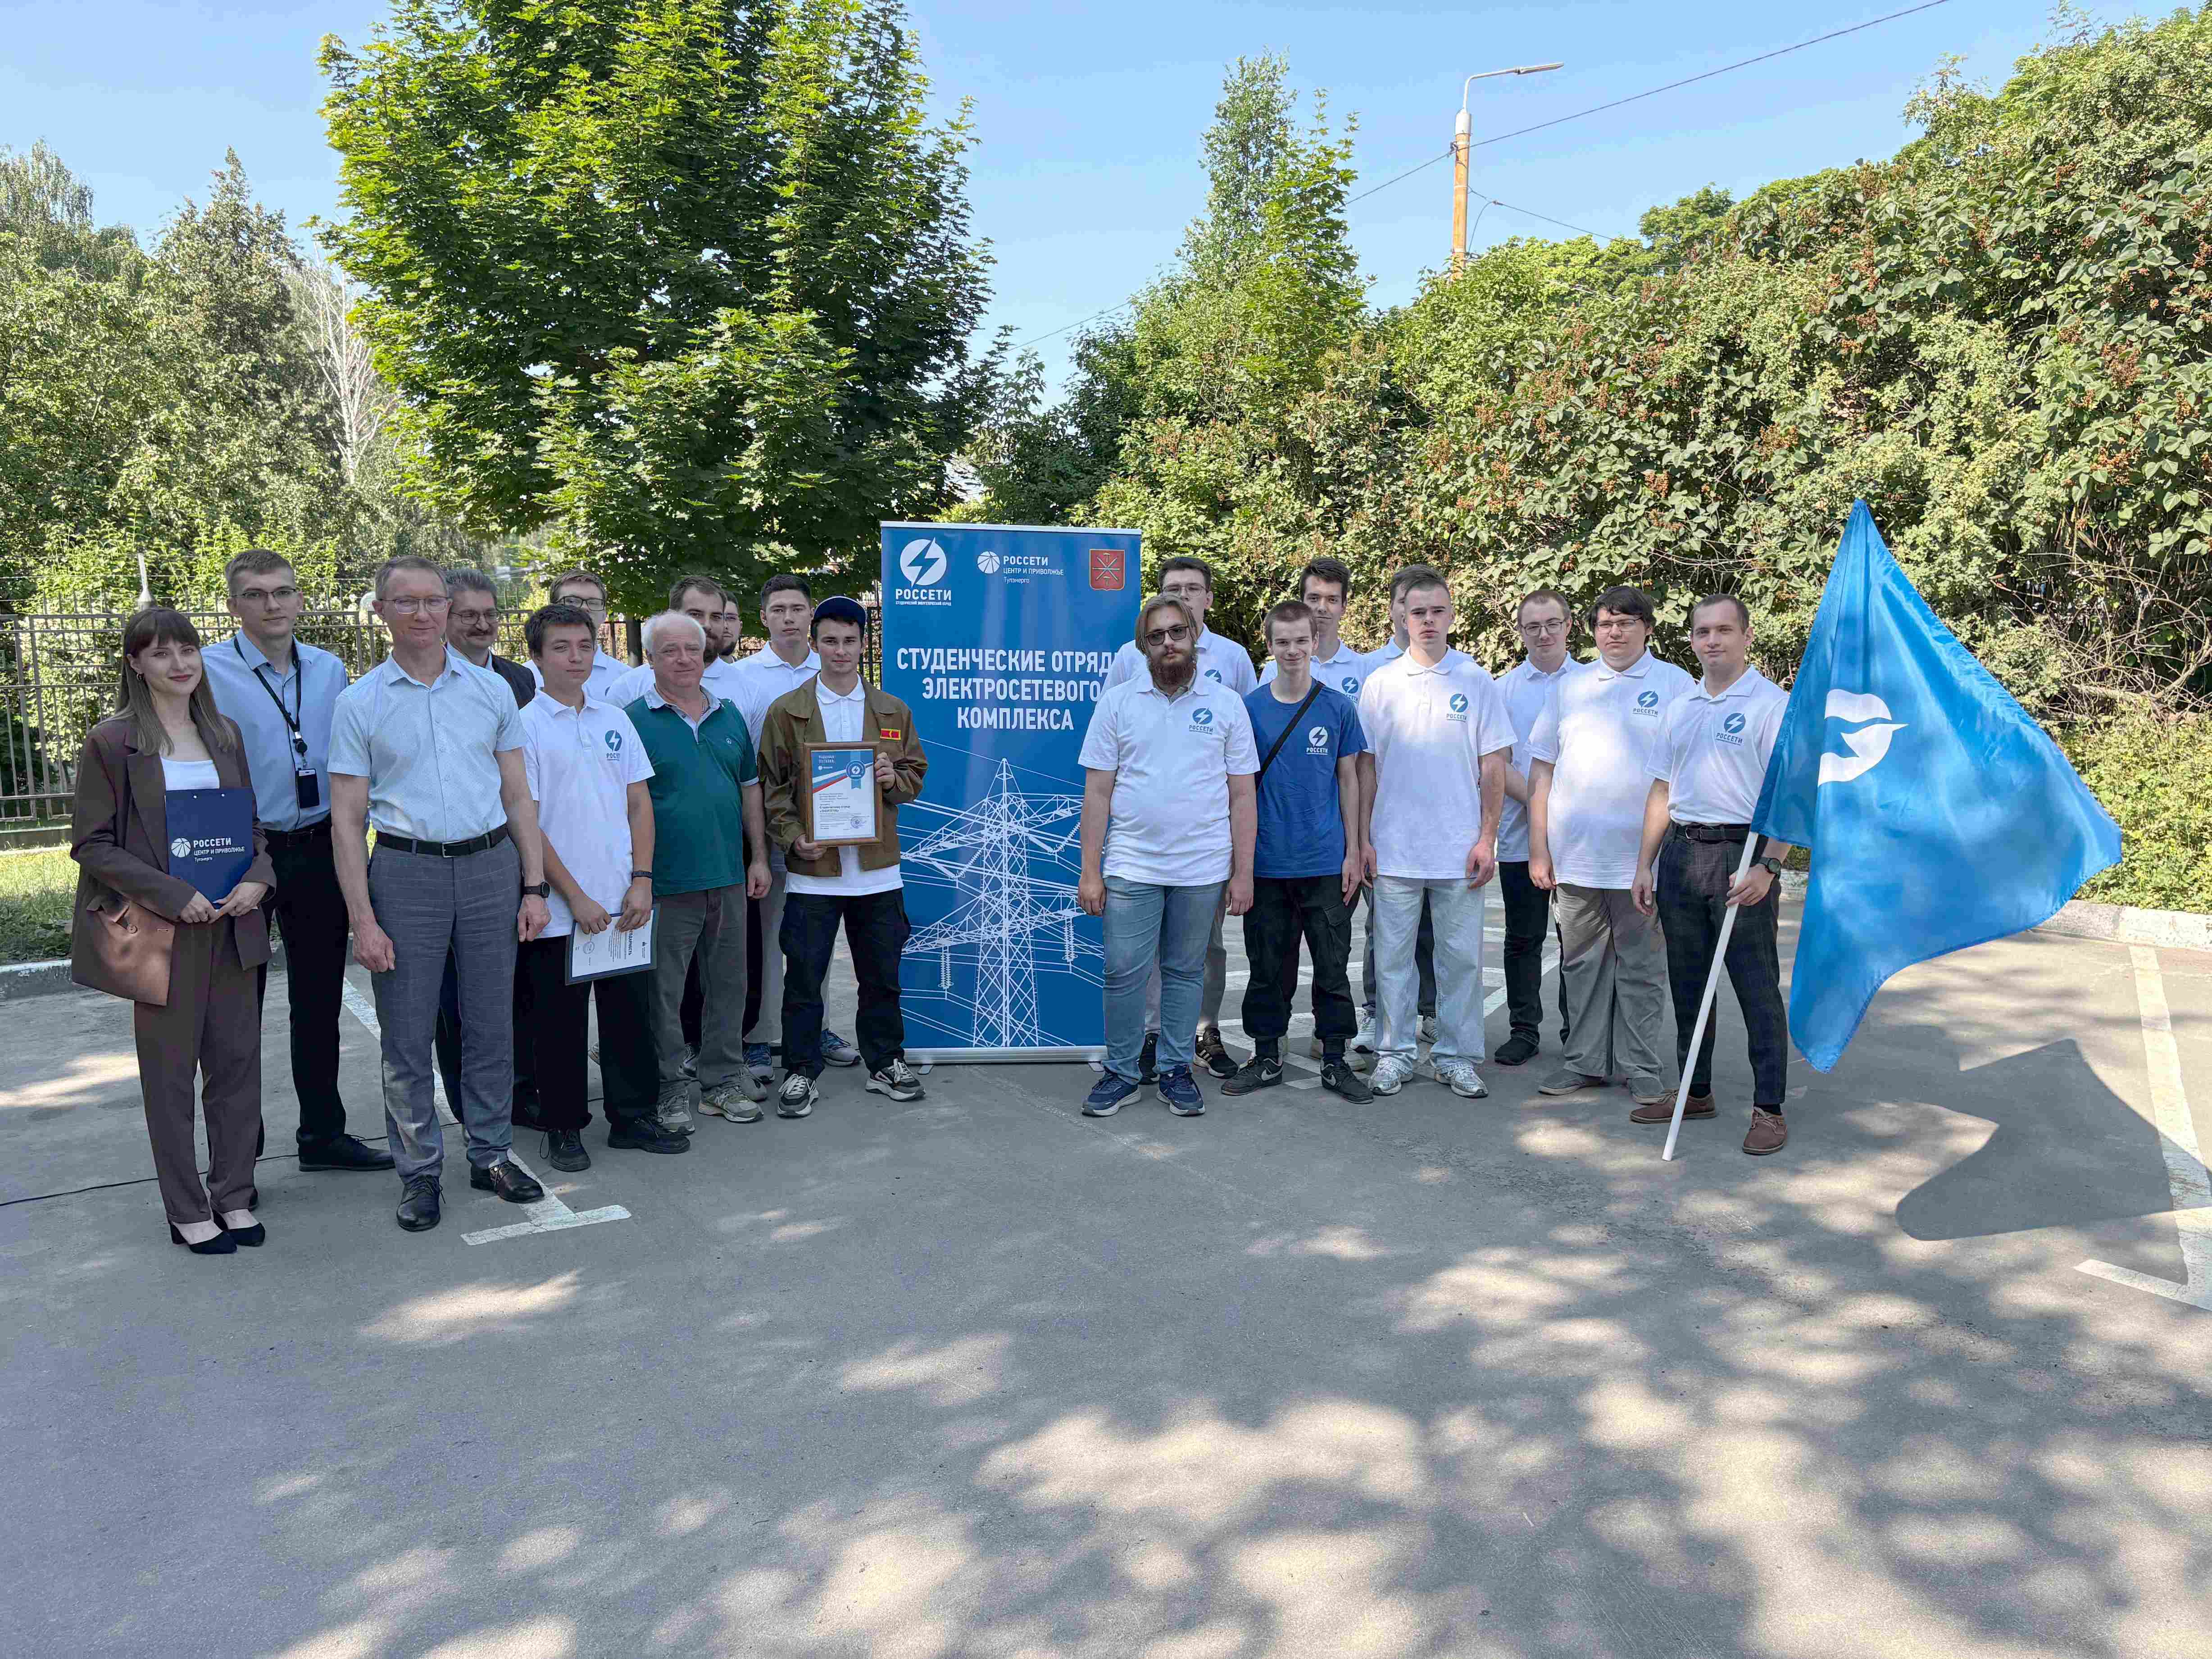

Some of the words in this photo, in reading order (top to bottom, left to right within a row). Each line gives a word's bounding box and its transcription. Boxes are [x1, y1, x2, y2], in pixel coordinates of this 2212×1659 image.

[1004, 556, 1049, 566] РОССЕТИ
[895, 589, 951, 600] РОССЕТИ
[897, 648, 1045, 674] СТУДЕНЧЕСКИЕ
[922, 677, 1100, 702] ЭЛЕКТРОСЕТЕВОГО
[958, 707, 1074, 730] КОМПЛЕКСА
[1716, 732, 1743, 743] РОССЕТИ
[193, 837, 232, 848] РОССЕТИ
